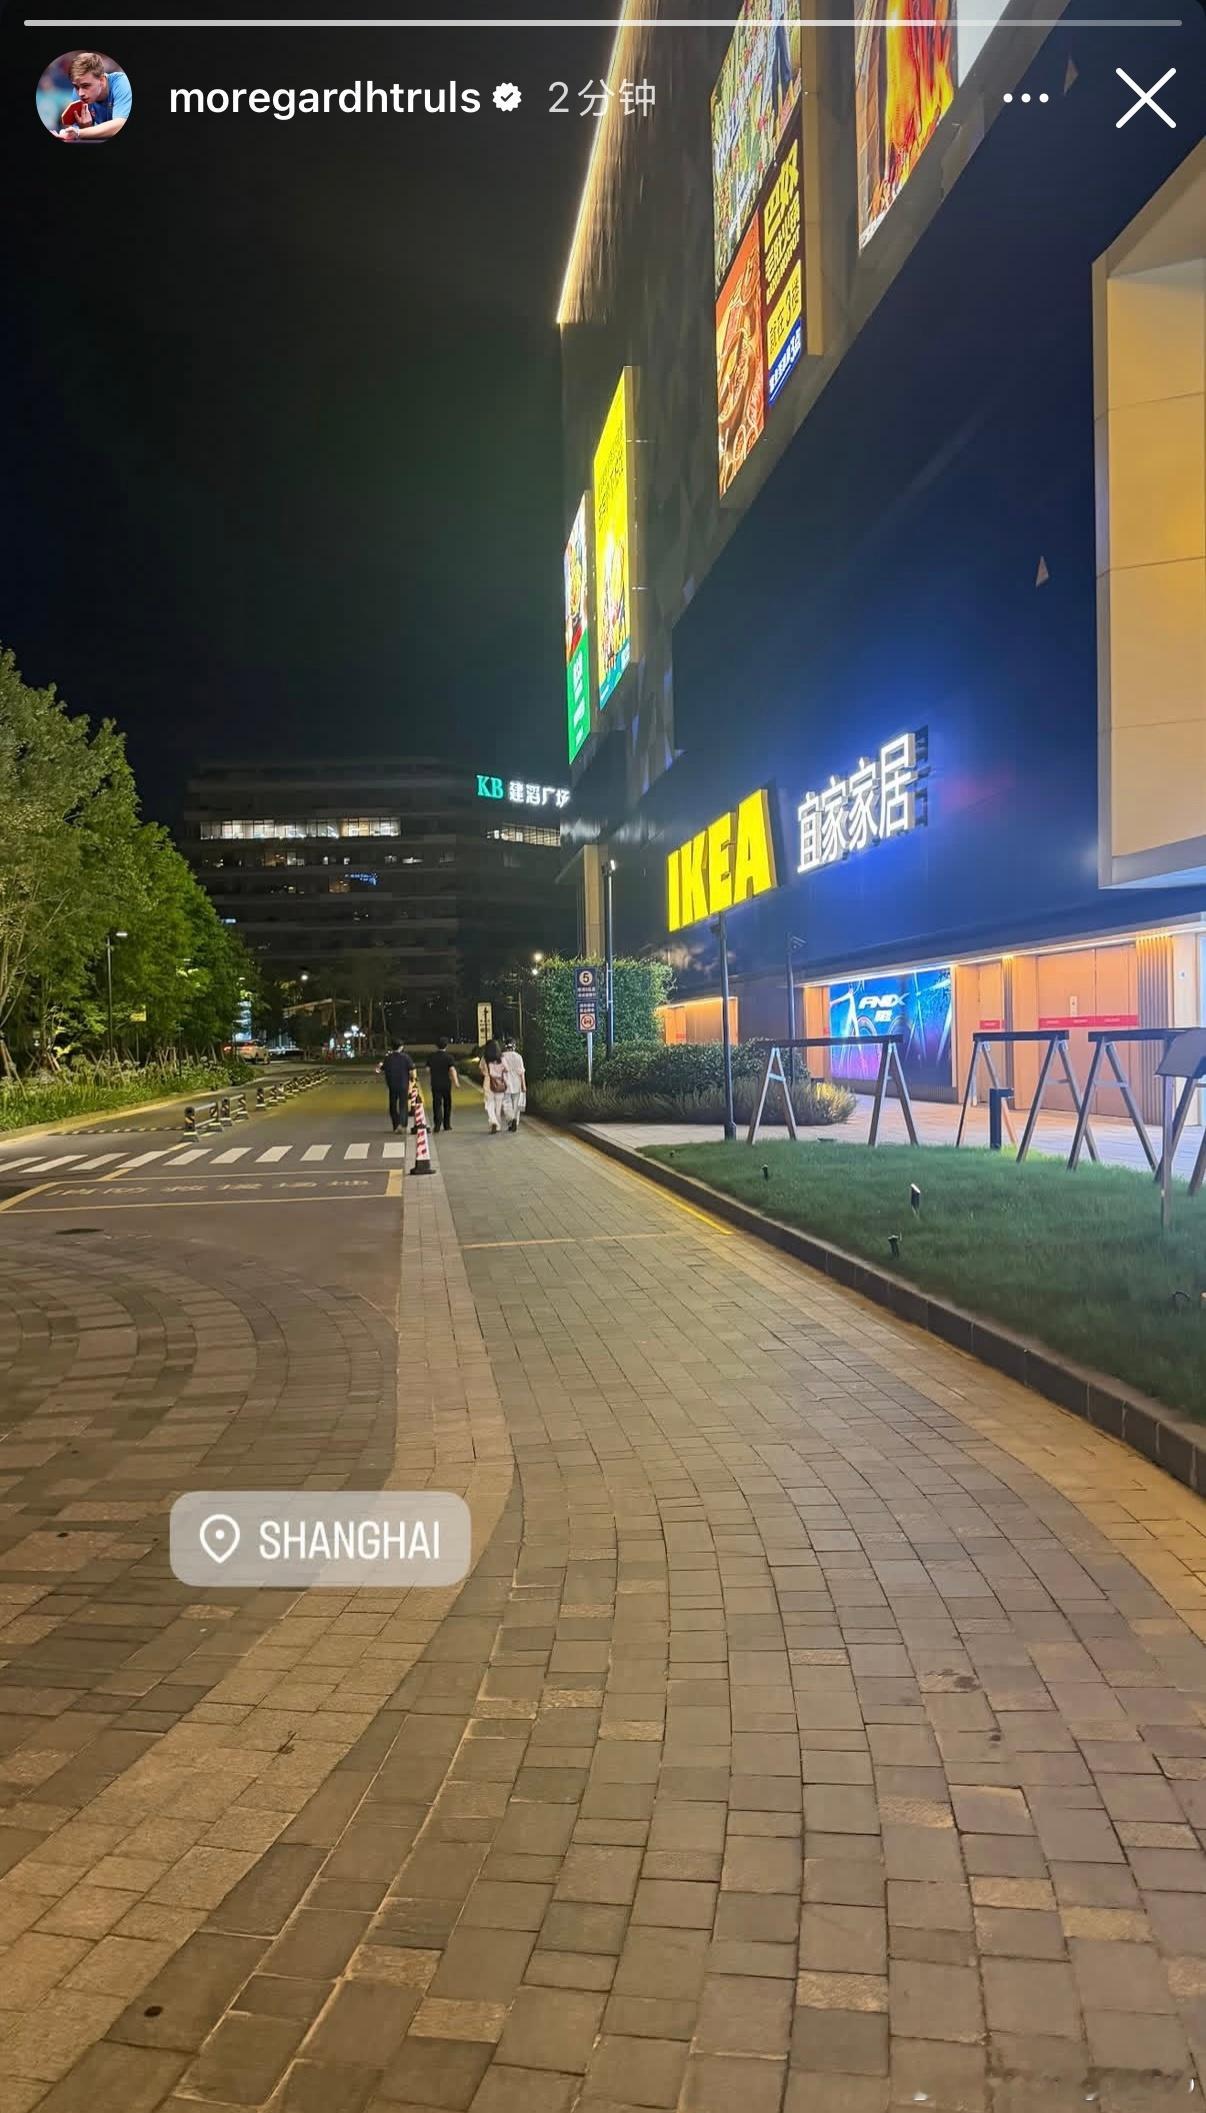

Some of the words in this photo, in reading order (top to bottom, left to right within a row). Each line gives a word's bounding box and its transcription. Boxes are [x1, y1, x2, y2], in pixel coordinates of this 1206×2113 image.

[476, 774, 505, 799] KB
[667, 788, 778, 933] IKEA
[797, 732, 917, 873] 宜家家居
[582, 972, 590, 983] 5
